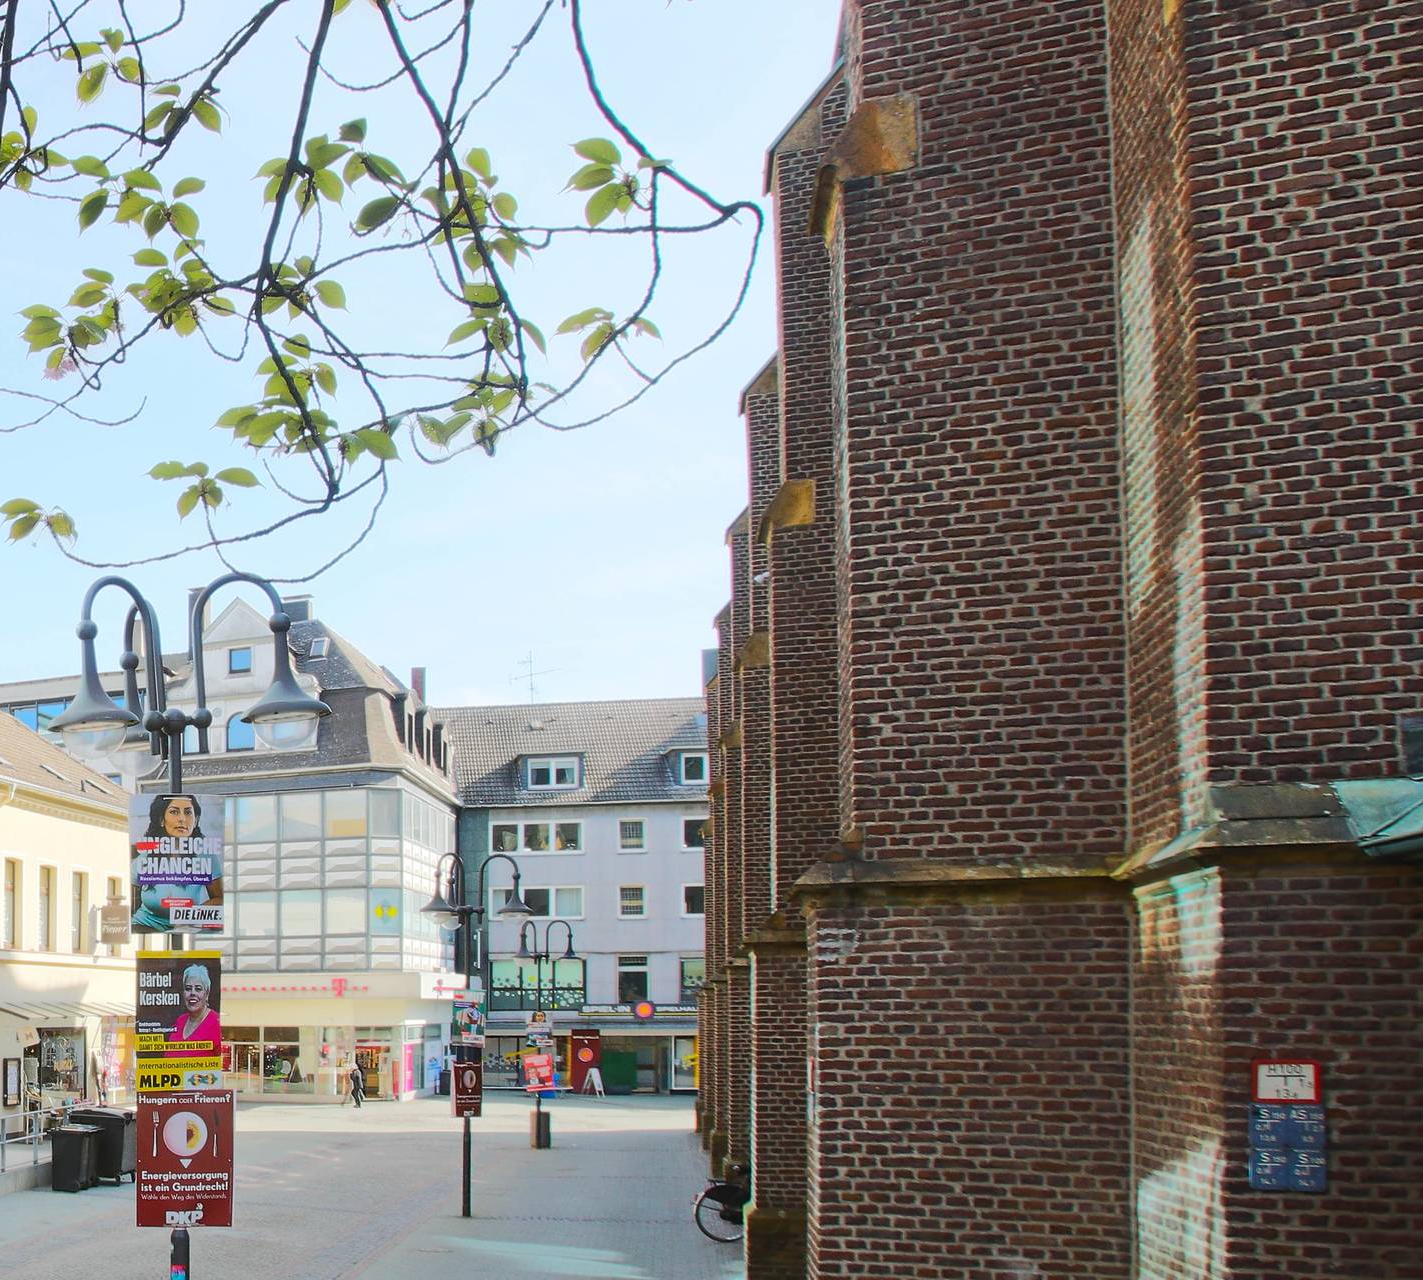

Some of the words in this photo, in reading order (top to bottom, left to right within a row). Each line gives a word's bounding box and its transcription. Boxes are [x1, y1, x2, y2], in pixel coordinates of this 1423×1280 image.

[137, 836, 223, 855] UNGLEICHE
[138, 856, 212, 875] CHANCEN
[174, 909, 191, 920] DIE
[139, 972, 172, 988] Bärbel
[139, 990, 180, 1006] Kersken
[140, 1074, 181, 1089] MLPD
[138, 1094, 177, 1106] Hungern
[194, 1094, 231, 1104] Frieren?
[141, 1170, 228, 1181] Energieversorgung
[141, 1183, 152, 1192] ist
[155, 1183, 169, 1192] ein
[172, 1181, 228, 1192] Grundrecht!
[171, 1193, 184, 1201] Weg
[165, 1210, 203, 1225] DKP
